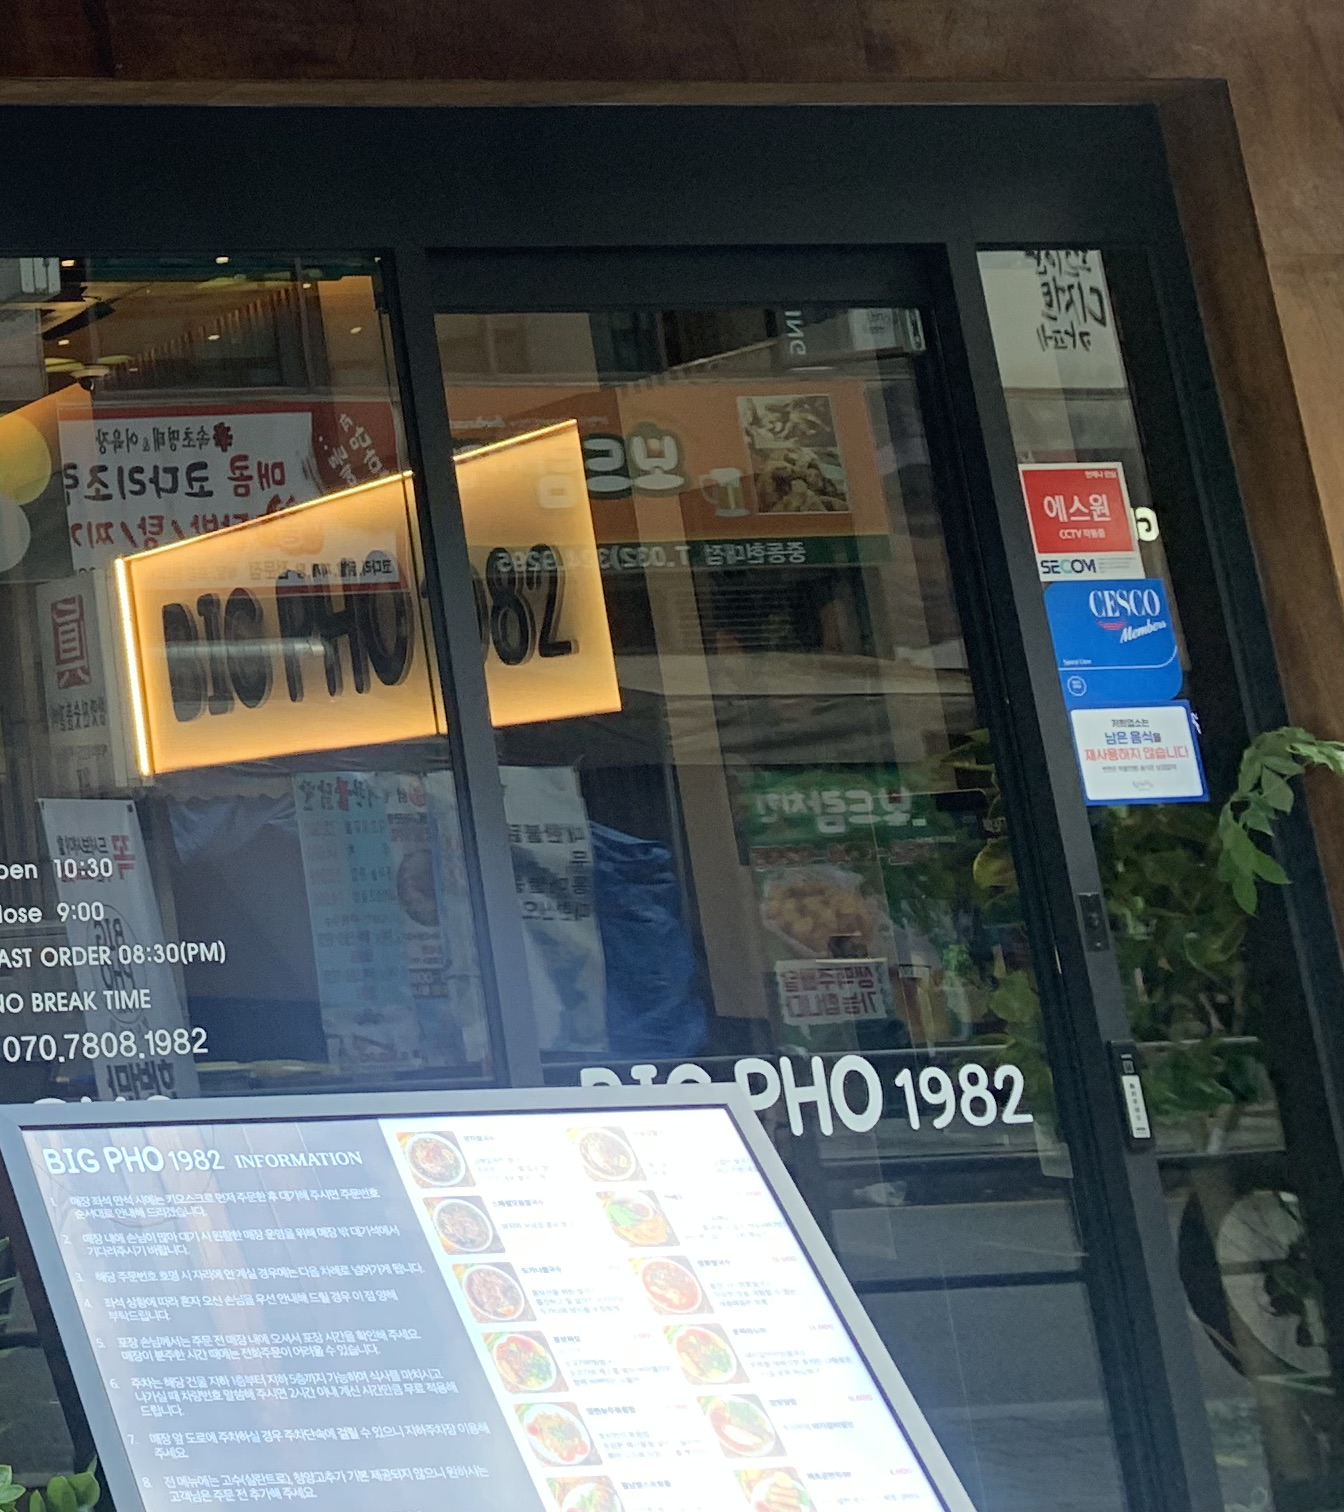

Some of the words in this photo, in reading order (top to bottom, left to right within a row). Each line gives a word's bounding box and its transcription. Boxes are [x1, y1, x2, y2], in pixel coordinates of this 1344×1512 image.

[1042, 493, 1111, 523] 에스원
[1058, 528, 1082, 540] CCTV
[1040, 559, 1097, 574] SECOM
[1088, 588, 1161, 618] CESCO
[162, 588, 273, 723] BIG
[277, 549, 411, 702] PHO
[472, 543, 579, 667] 82
[1119, 618, 1167, 644] Members
[1104, 731, 1128, 745] 남은
[54, 858, 113, 878] 10:30
[56, 902, 105, 922] 9:00
[40, 946, 112, 967] ORDER
[118, 940, 227, 965] 08:30(PM)
[31, 991, 98, 1012] BREAK
[103, 989, 152, 1010] TIME
[2, 1027, 209, 1063] 070.7808.1982
[735, 1055, 884, 1137] PHO
[894, 1063, 1035, 1131] 1982
[43, 1148, 100, 1175] BIG
[103, 1146, 165, 1173] PHO
[167, 1149, 226, 1172] 1982
[234, 1151, 363, 1169] INFORMATION
[70, 1195, 91, 1207] 매장
[92, 1195, 113, 1206] 좌석
[136, 1194, 166, 1206] 시에는
[216, 1193, 236, 1204] 먼저
[237, 1190, 266, 1203] 주문한
[280, 1189, 310, 1202] 대기해
[311, 1188, 339, 1201] 주시면
[340, 1187, 381, 1200] 주문번호
[74, 1208, 114, 1220] 순서대로
[116, 1207, 146, 1219] 안내해
[82, 1233, 104, 1244] 매장
[104, 1232, 126, 1243] 내에
[127, 1232, 156, 1244] 손님이
[157, 1231, 178, 1243] 많아
[179, 1231, 200, 1243] 대기
[201, 1230, 212, 1241] 시
[243, 1229, 264, 1241] 매장
[296, 1227, 318, 1239] 위해
[318, 1226, 338, 1239] 매장
[121, 1350, 154, 1363] 매장이
[155, 1349, 186, 1362] 분주한
[187, 1349, 208, 1361] 시간
[241, 1346, 293, 1360] 전화주문이
[325, 1344, 337, 1356] 수
